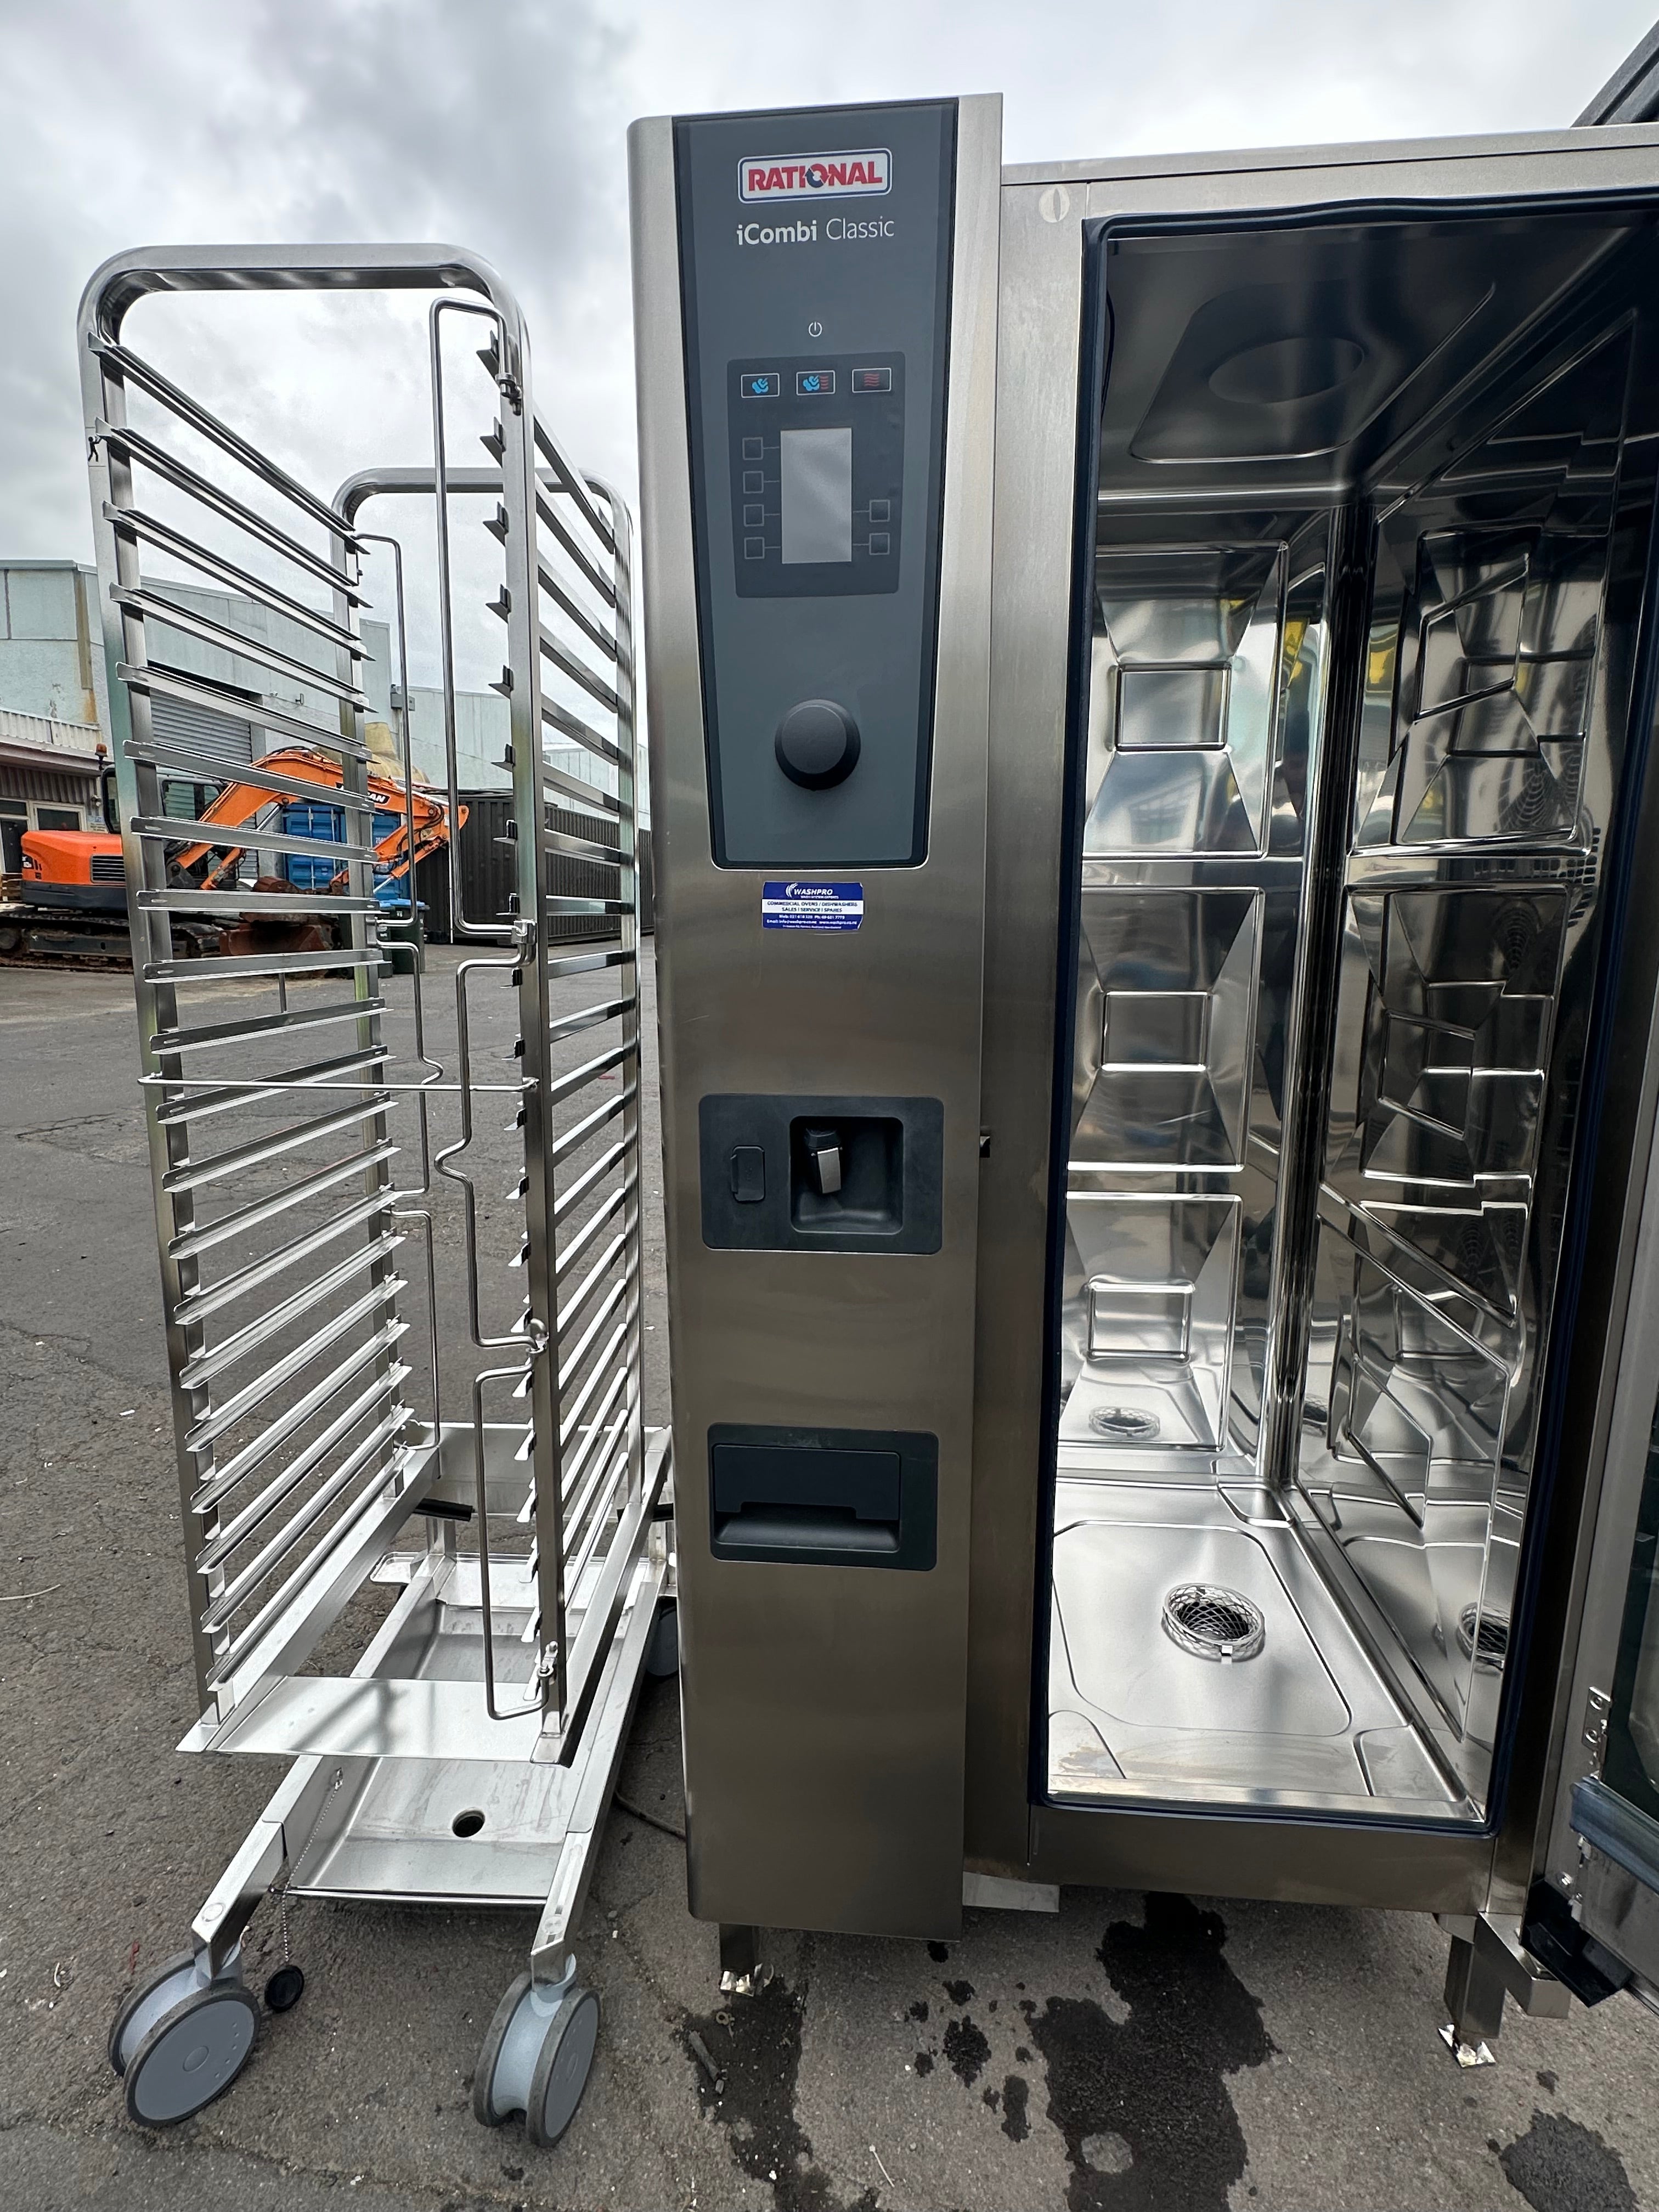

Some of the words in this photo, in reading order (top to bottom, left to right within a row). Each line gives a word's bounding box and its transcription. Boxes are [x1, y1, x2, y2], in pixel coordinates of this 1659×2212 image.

[748, 161, 883, 191] RATIONAL
[737, 220, 817, 245] iCombi
[826, 216, 895, 240] Classic
